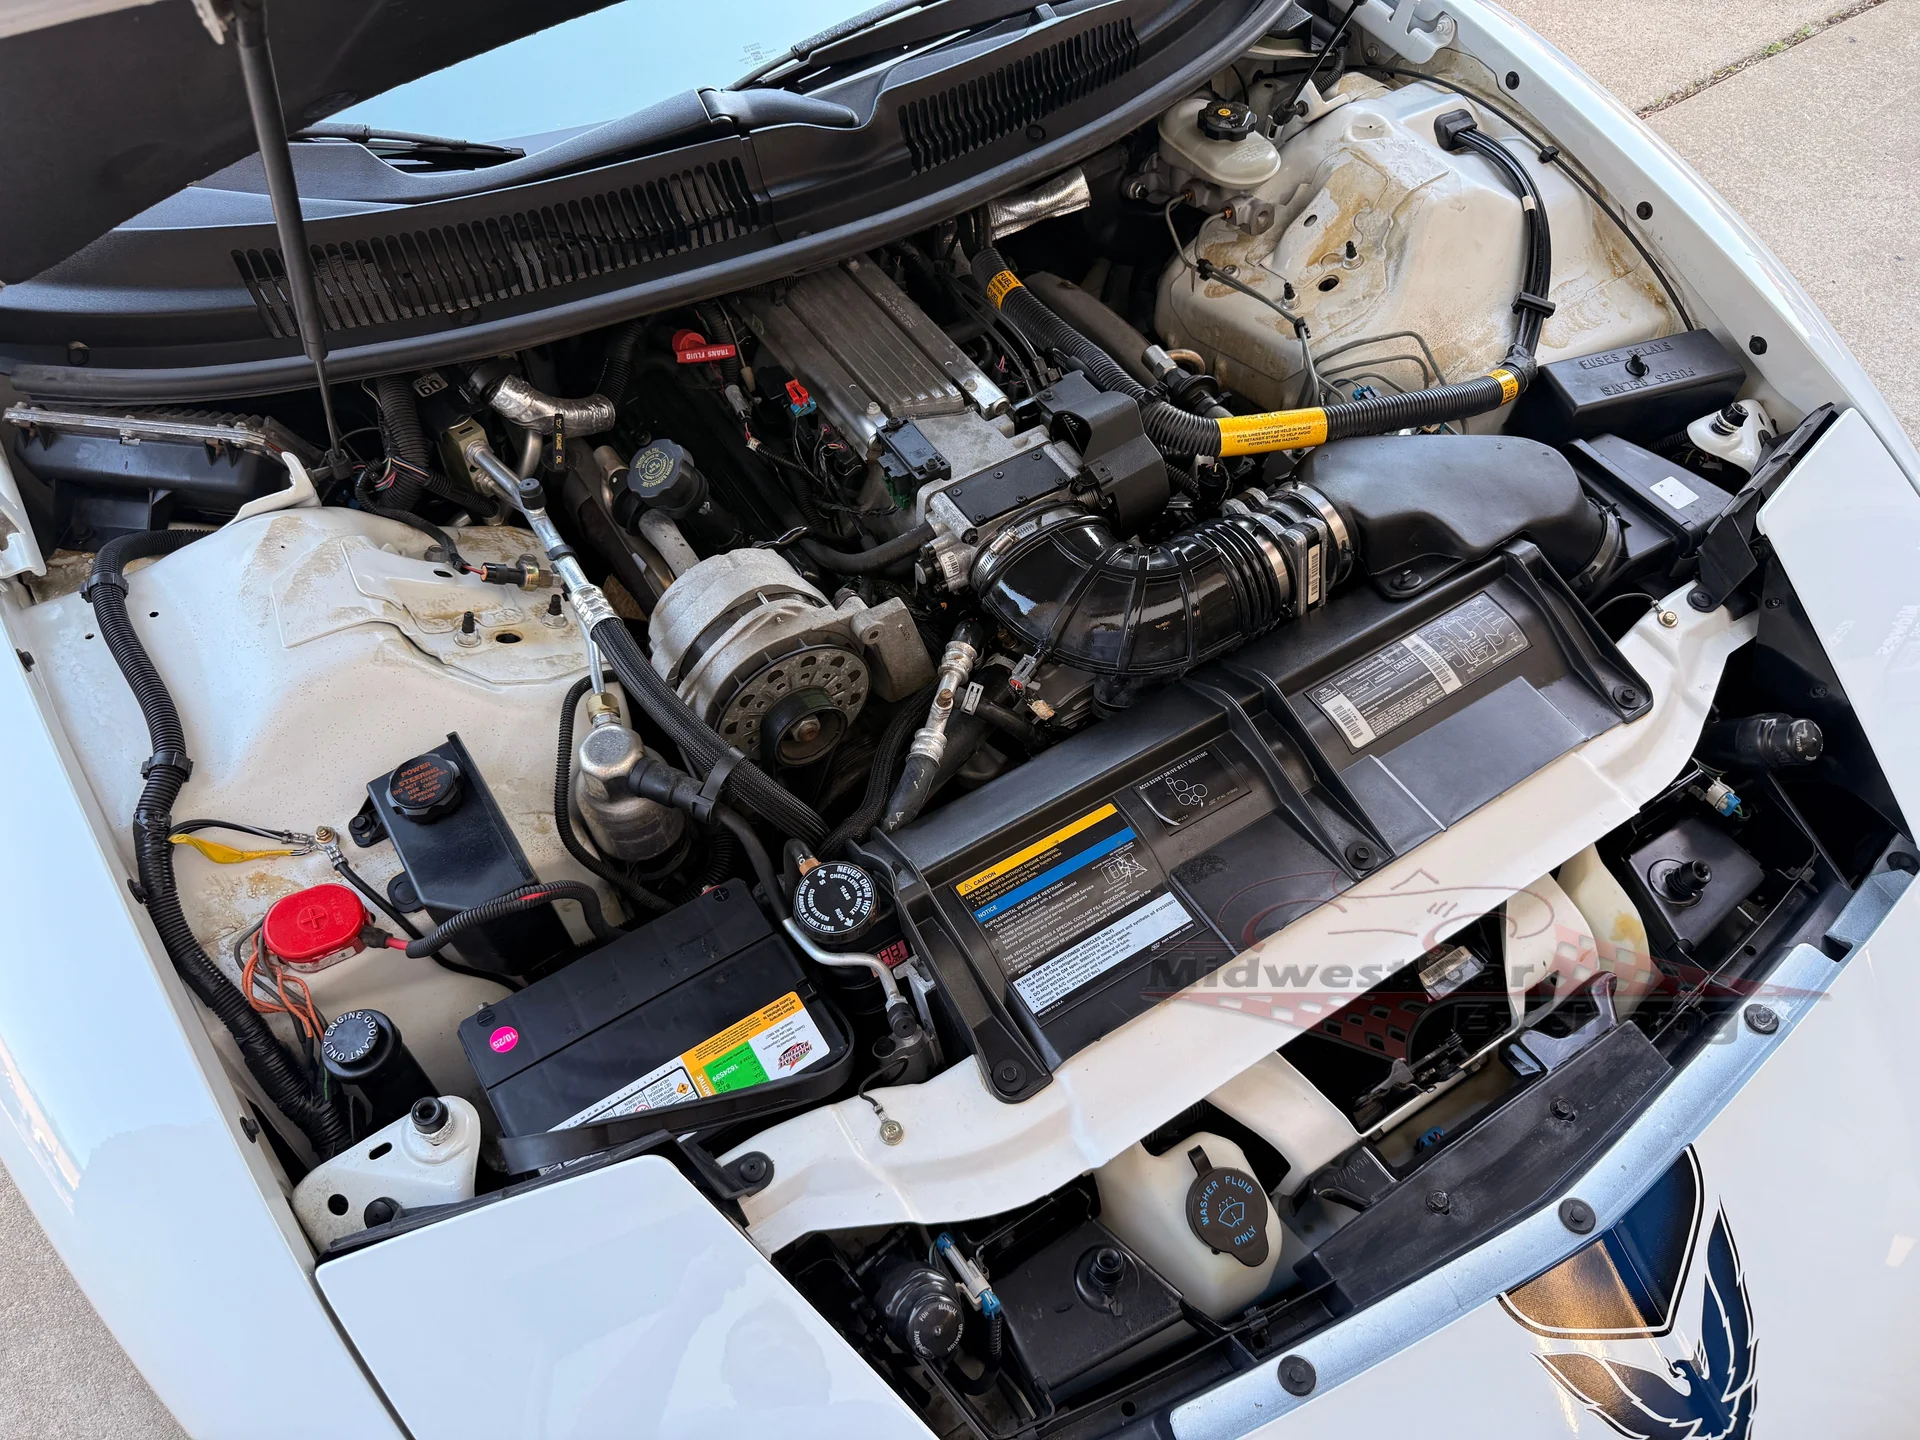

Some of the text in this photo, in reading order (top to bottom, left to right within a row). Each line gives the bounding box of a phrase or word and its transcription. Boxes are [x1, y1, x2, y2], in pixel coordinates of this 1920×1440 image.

[999, 273, 1012, 287] FUEL
[988, 287, 999, 301] FUEL
[685, 349, 728, 359] TRANS FLUID
[1580, 342, 1673, 369] FUSES RELAYS
[418, 377, 444, 396] 60
[1601, 367, 1696, 396] FUSES RELAYS
[1505, 387, 1516, 396] FUEL
[1393, 653, 1416, 670] CATALYST
[1335, 676, 1350, 686] VEHICLE
[1349, 667, 1366, 678] EMISSION
[399, 767, 439, 786] STEERING
[401, 762, 431, 777] POWER
[420, 769, 448, 783] OVERFILL
[1138, 750, 1208, 790] ACCESSORY DRIVE BELT ROUTING
[410, 784, 441, 800] APPROVED
[424, 780, 438, 788] ONLY
[418, 793, 435, 802] FLUID
[829, 873, 848, 881] CHECK
[965, 846, 1059, 900] FAN BLADE STARTS WITHOUT ENGINE RUNNING.
[972, 870, 996, 886] CAUTION
[836, 865, 871, 914] NEVER OPEN HOT
[846, 876, 860, 891] LEVEL
[798, 879, 809, 894] ALIGN
[806, 915, 819, 928] VENT
[806, 888, 829, 921] CLOSED SYSTEM
[848, 897, 862, 914] BOTTLE
[977, 904, 998, 918] NOTICE
[983, 880, 1065, 928] SUPPLEMENTAL INFLATABLE RESTRAINT.
[1002, 953, 1013, 962] THIS
[1012, 943, 1032, 957] VEHICLE
[1030, 931, 1053, 946] REQUIRES
[1055, 919, 1074, 932] SPECIAL
[1072, 908, 1093, 922] COOLANT
[1092, 903, 1102, 911] FILL
[1101, 889, 1127, 906] PROCEDURE.
[1016, 928, 1114, 987] R-134a (FOR AIR CONDITIONED VEHICLES ONLY)
[766, 1007, 782, 1018] batteries
[768, 1005, 794, 1021] Return warranty
[324, 1012, 376, 1060] ENGINE COOLANT ONLY
[492, 1031, 516, 1050] 10/25
[742, 1052, 753, 1061] ITEM
[775, 1043, 814, 1068] INTERSTATE
[776, 1041, 809, 1062] BATTERIES
[710, 1062, 739, 1082] 1624539
[658, 1077, 669, 1086] HELP
[714, 1078, 724, 1087] 95
[717, 1082, 731, 1093] 875
[647, 1086, 665, 1098] MEDICAL
[663, 1086, 674, 1094] WITH
[623, 1101, 637, 1112] REACH
[651, 1090, 676, 1107] IMMEDIATELY
[1200, 1176, 1256, 1245] WASHER FLUID ONLY
[919, 1311, 928, 1321] FOR
[938, 1304, 957, 1316] MANUAL
[947, 1323, 962, 1351] OPERATION
